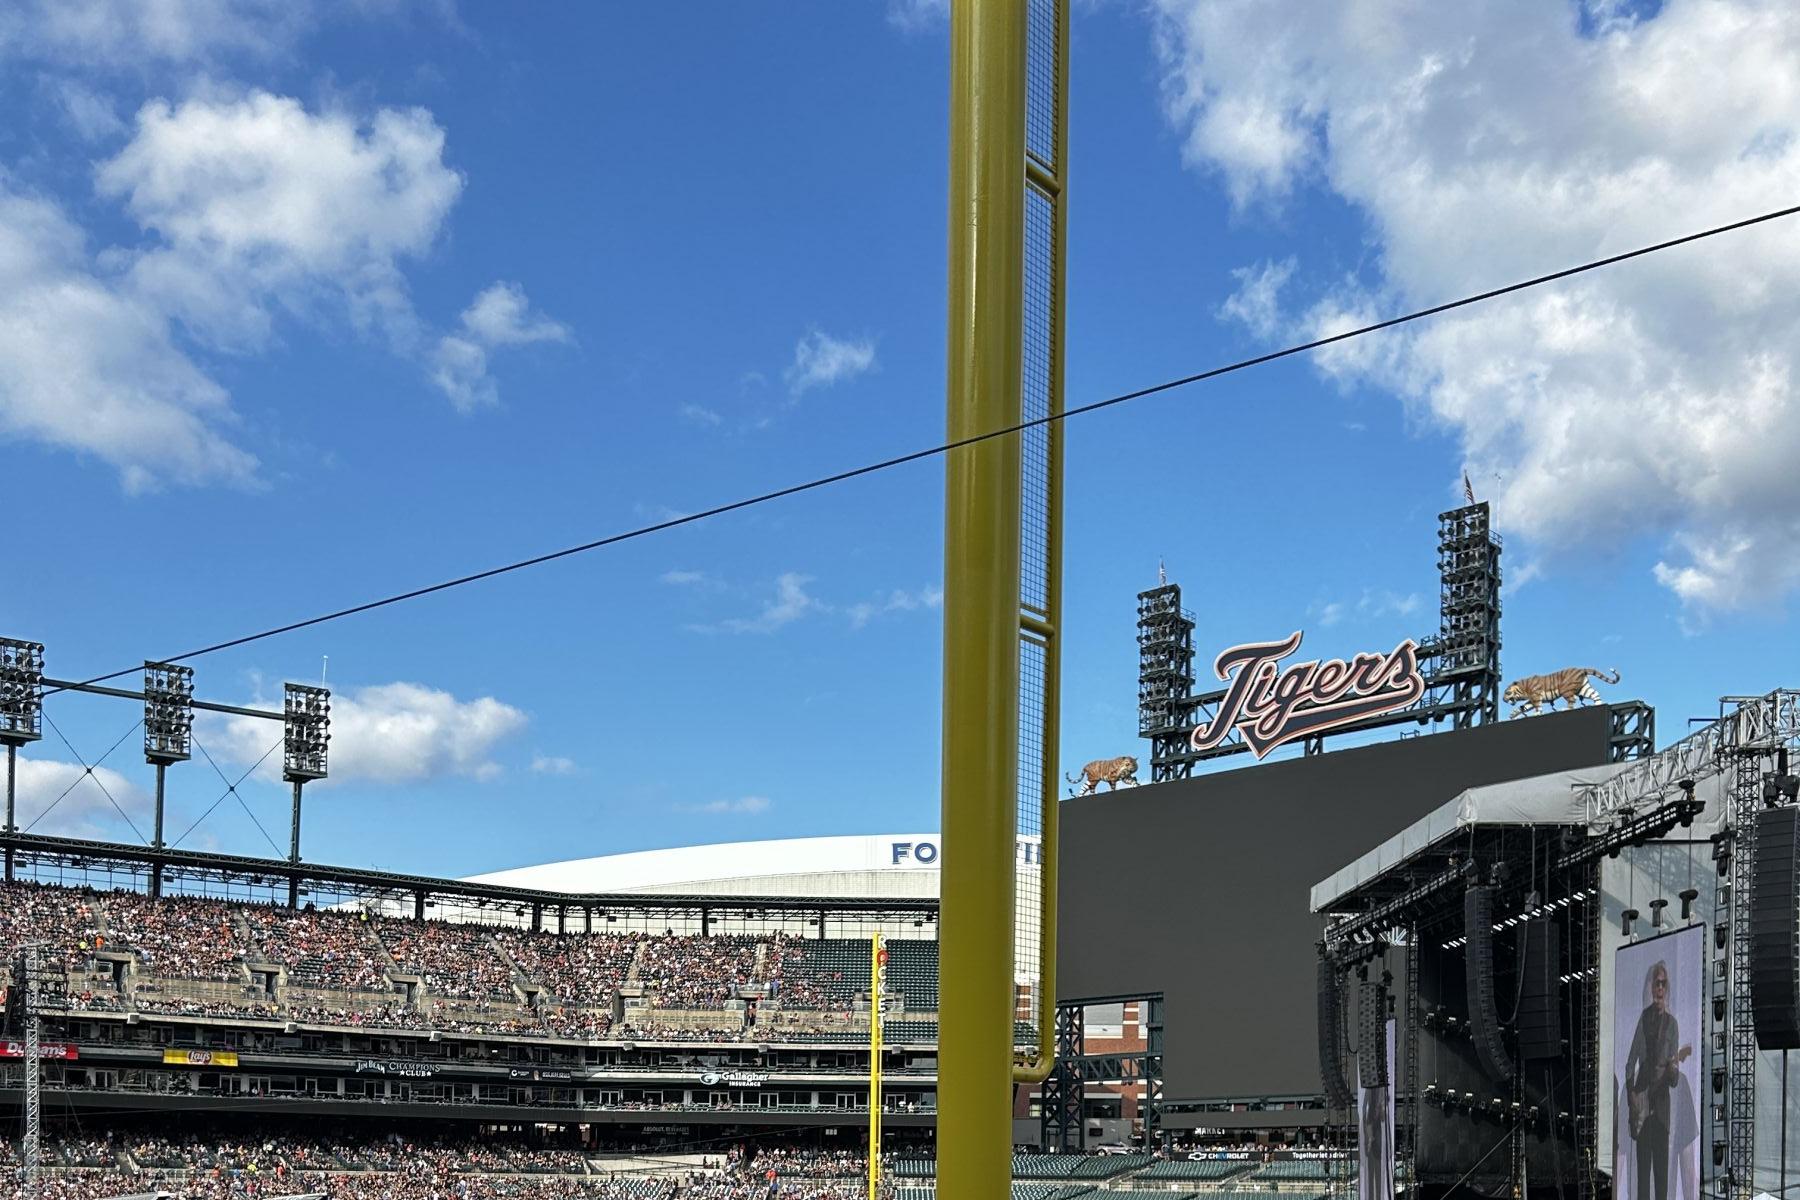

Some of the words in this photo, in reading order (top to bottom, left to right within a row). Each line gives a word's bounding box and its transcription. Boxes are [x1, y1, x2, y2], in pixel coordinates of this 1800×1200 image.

[1191, 630, 1425, 760] Tigers
[892, 842, 938, 865] FO
[877, 935, 889, 1028] ROCKET
[7, 1042, 67, 1056] Duam's
[388, 1062, 441, 1072] CHAMPIONS
[721, 1071, 769, 1082] Gallagher
[1208, 1152, 1249, 1160] CHEVROLET
[1292, 1152, 1319, 1160] Together
